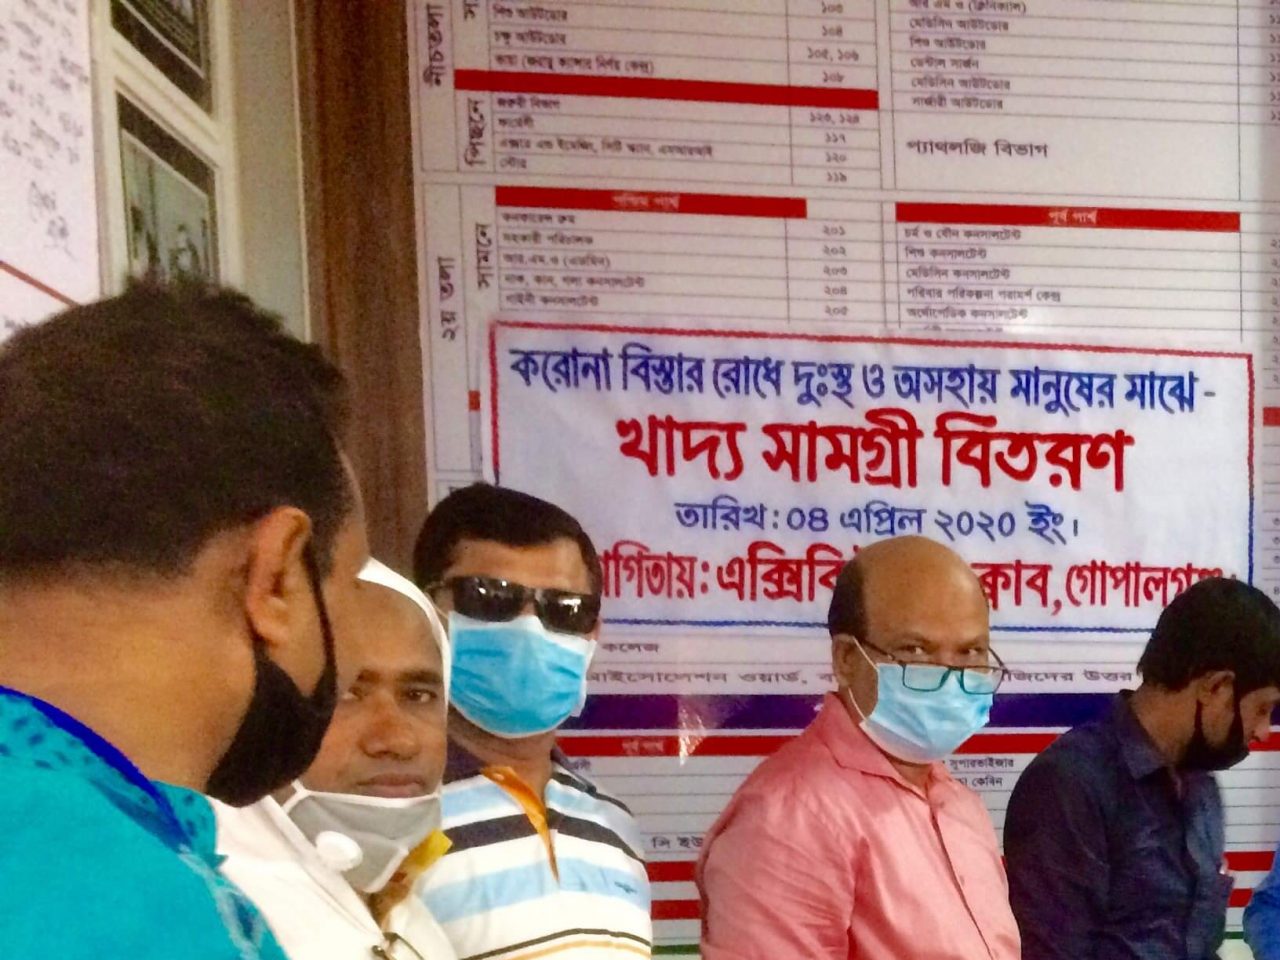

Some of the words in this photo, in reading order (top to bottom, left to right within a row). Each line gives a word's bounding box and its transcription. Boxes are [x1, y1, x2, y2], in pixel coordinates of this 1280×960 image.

[993, 138, 1049, 158] বিভাগ
[509, 347, 613, 393] করোনা
[618, 341, 706, 395] বিস্তার
[712, 356, 786, 400] রোধে
[792, 359, 856, 408] দুঃস্থ
[862, 363, 886, 398] ও
[892, 362, 1002, 409] অসহায়
[1009, 365, 1118, 416] মানুষের
[615, 413, 748, 481] খাদ্য
[761, 406, 925, 491] সামগ্রী
[933, 410, 1136, 493] বিতরণ
[839, 499, 927, 536] এপ্রিল
[934, 509, 1016, 542] ২০২০
